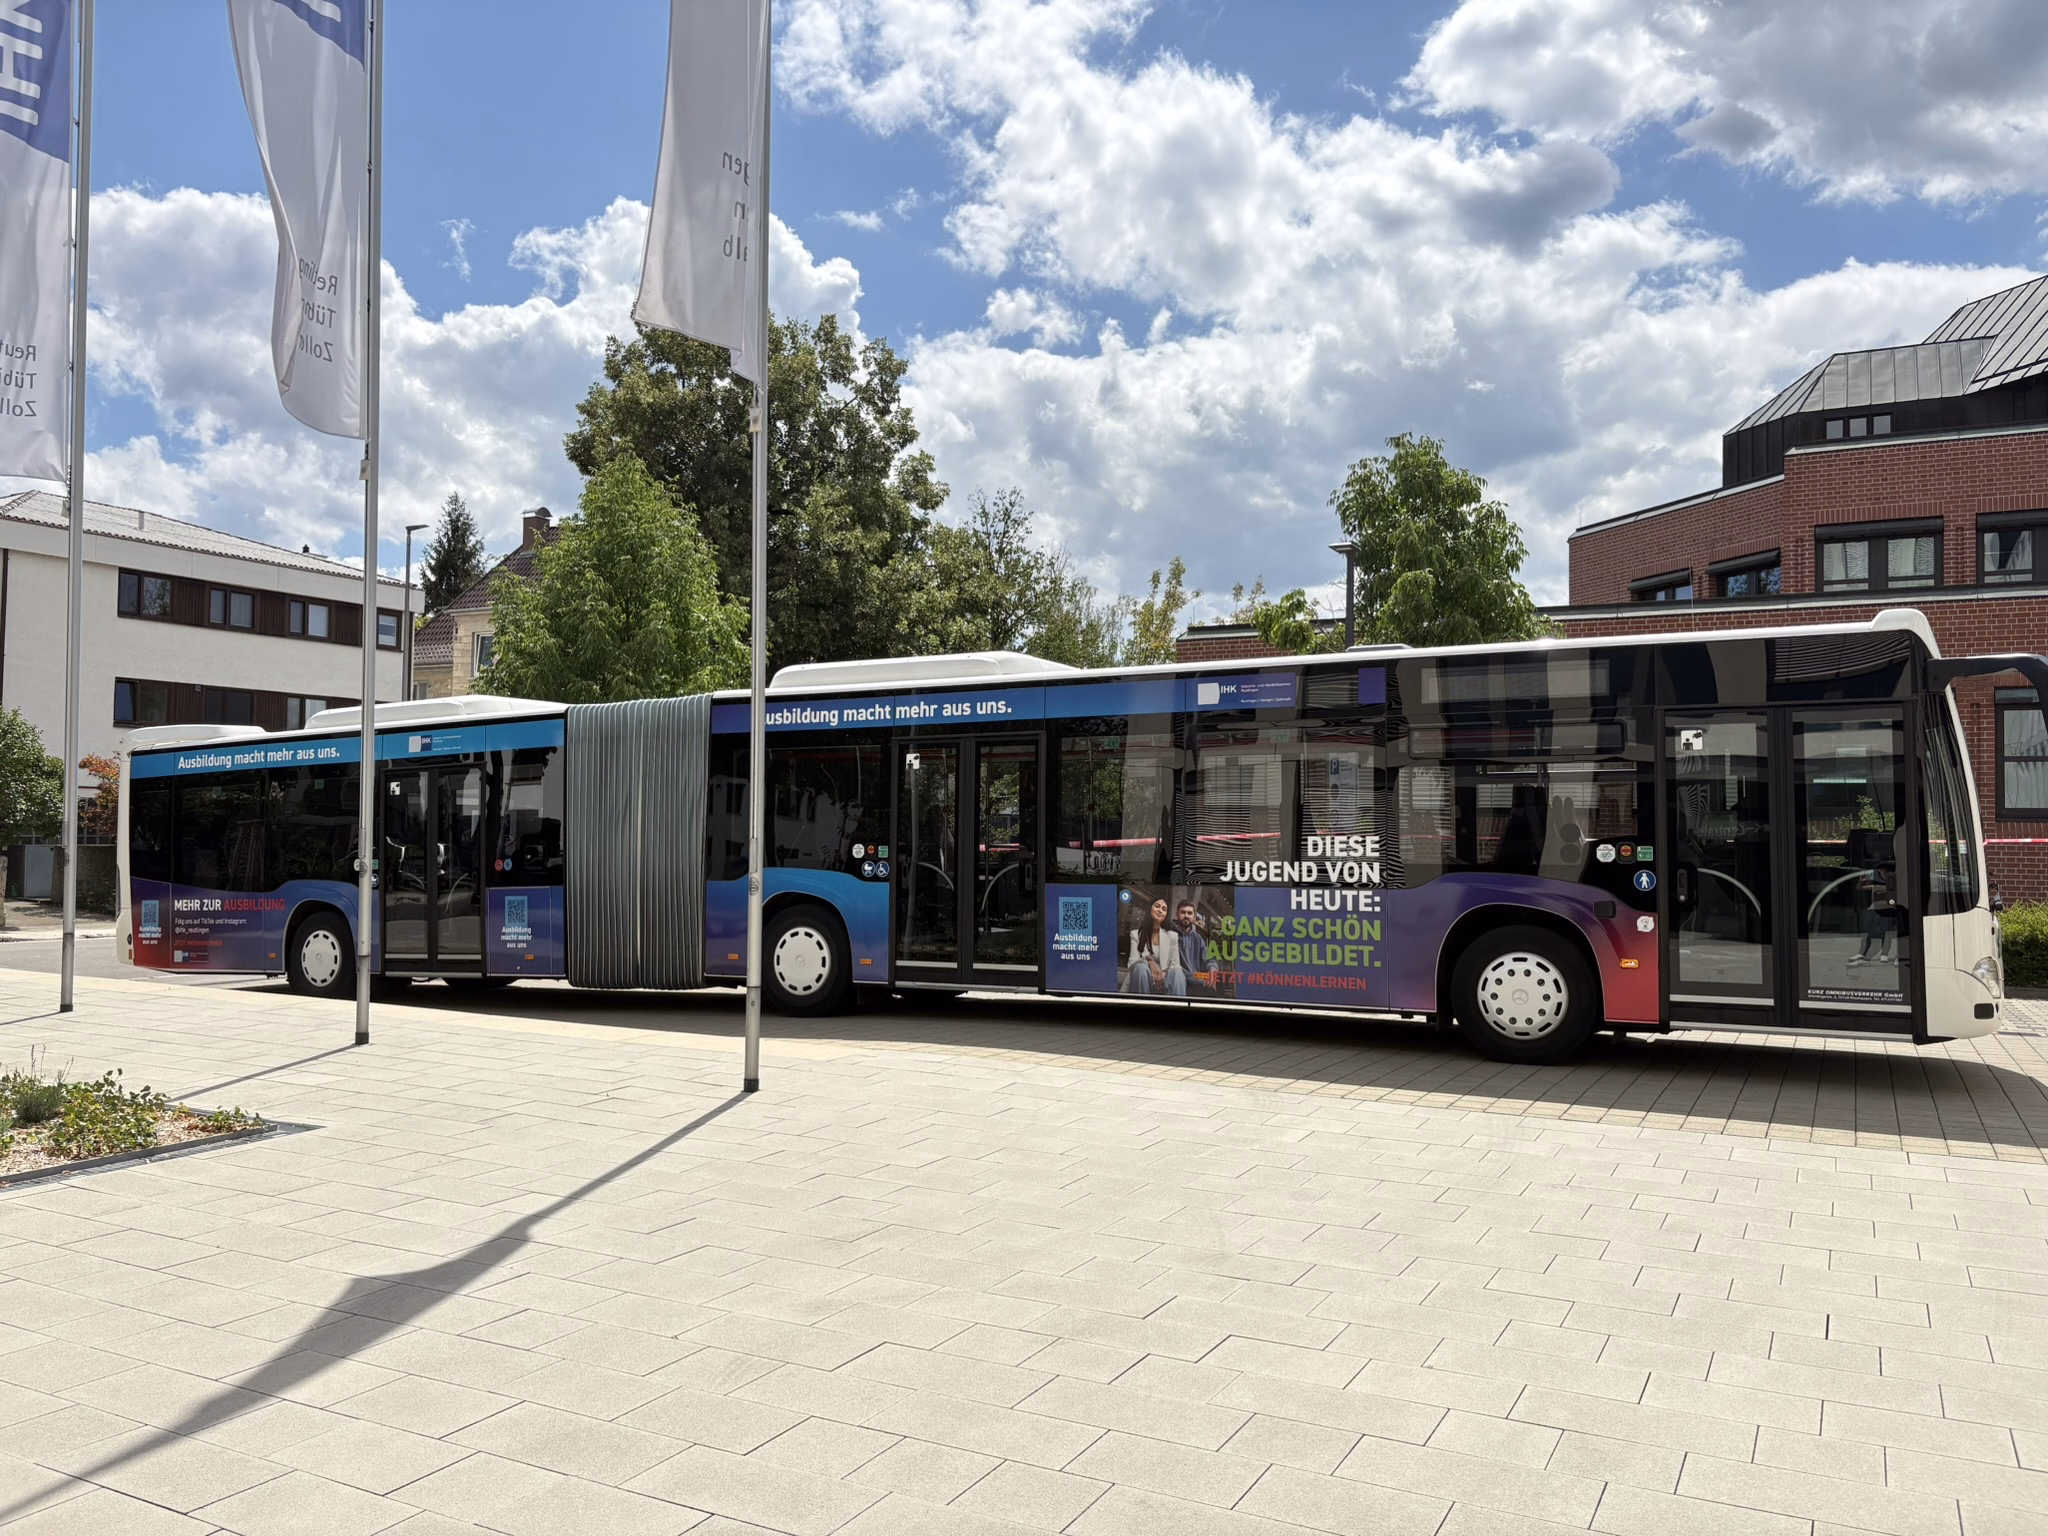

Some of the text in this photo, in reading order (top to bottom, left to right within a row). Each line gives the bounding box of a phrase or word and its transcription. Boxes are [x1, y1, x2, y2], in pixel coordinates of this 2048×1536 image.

[1220, 684, 1237, 694] IHK
[764, 700, 1012, 727] usbildung macht mehr aus uns.
[421, 737, 432, 745] IHK
[178, 746, 340, 770] Ausbildung macht mehr aus uns.
[1307, 836, 1380, 857] DIESE
[1219, 861, 1380, 883] JUGEND VON
[174, 898, 285, 911] MEHR ZUR AUSBILDUNG
[1290, 889, 1381, 912] HEUTE:
[501, 926, 532, 934] Ausbildung
[1221, 914, 1381, 941] GANZ SCHÖN
[1052, 942, 1099, 952] macht mehr
[1054, 933, 1098, 944] Ausbildung
[1076, 953, 1091, 961] uns
[1205, 940, 1382, 967] AUSGEBILDET.
[1247, 971, 1367, 991] #KÖNNENLERNEN
